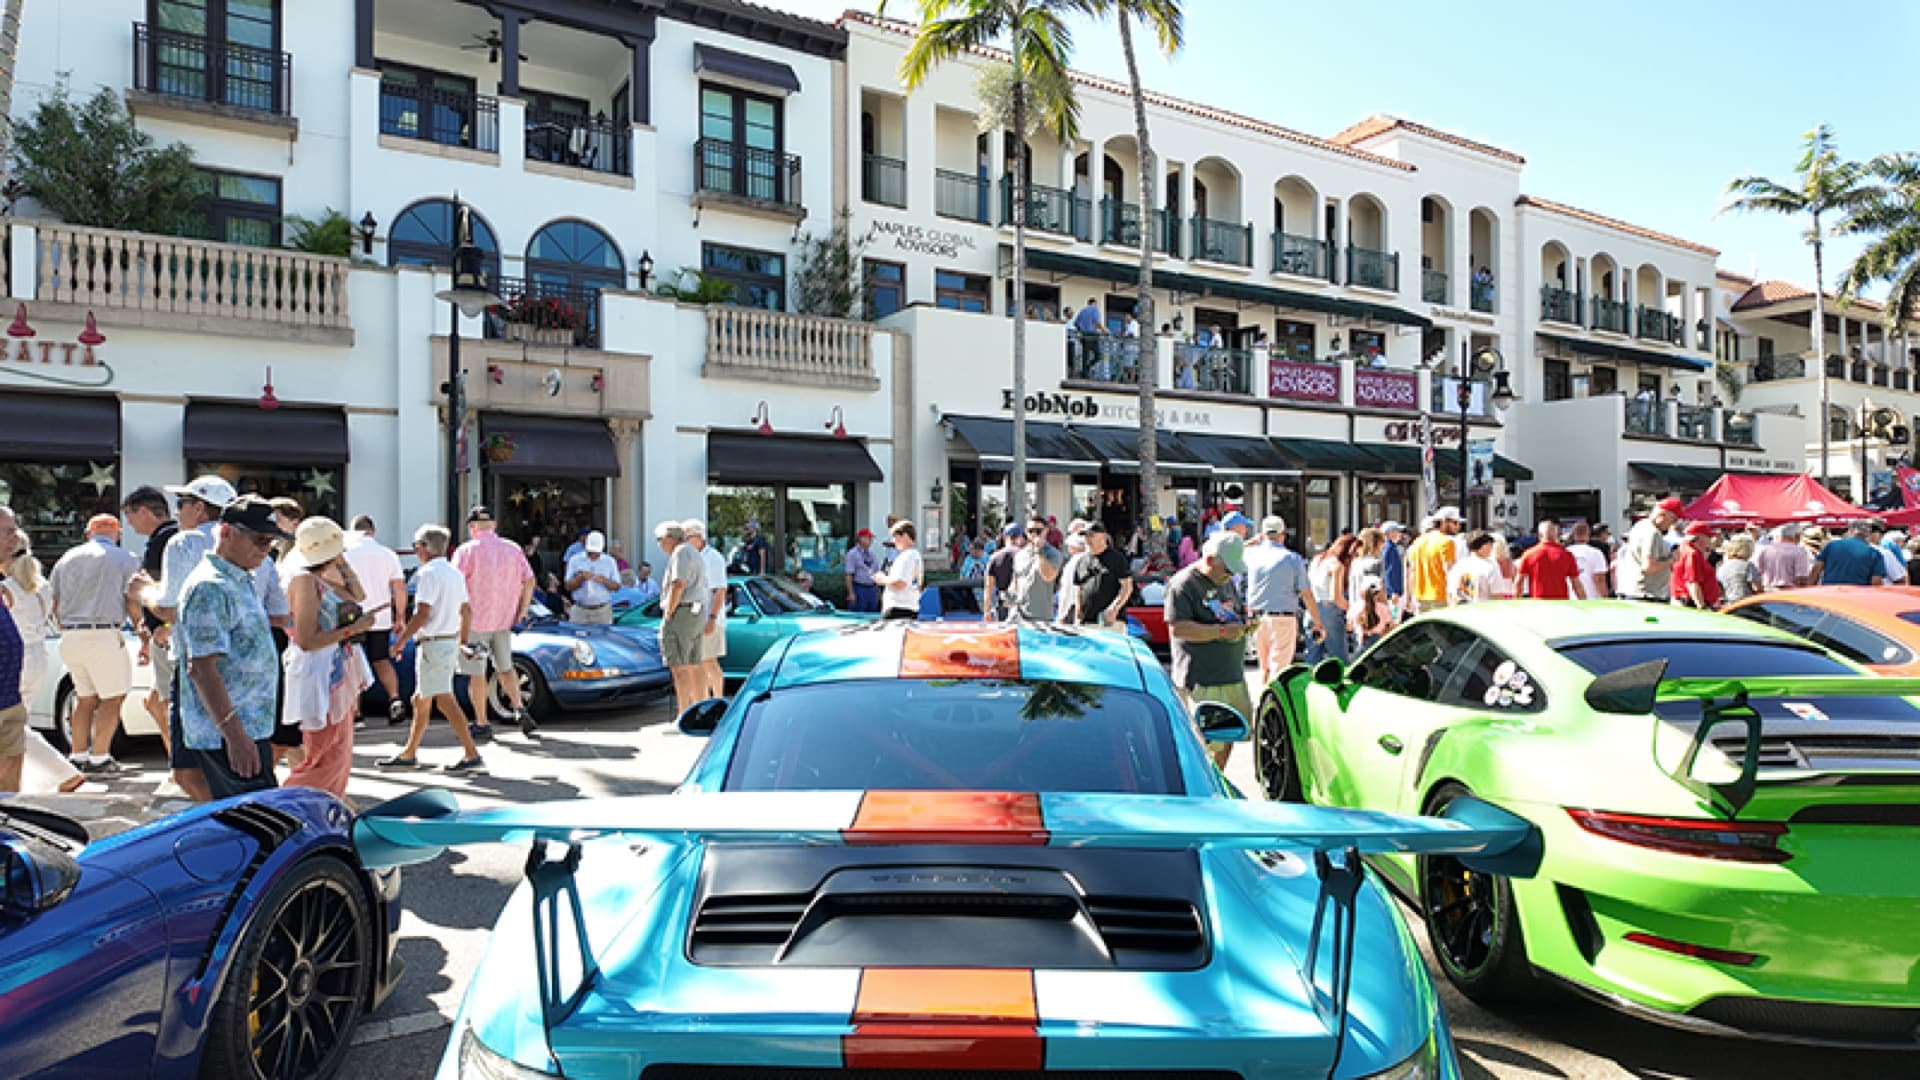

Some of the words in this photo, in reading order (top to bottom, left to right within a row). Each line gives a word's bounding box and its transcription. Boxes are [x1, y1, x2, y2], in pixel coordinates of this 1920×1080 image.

[873, 219, 923, 239] NAPLES
[926, 230, 976, 249] GLOBAL
[895, 237, 958, 258] ADVISORS
[1271, 376, 1336, 397] ADVISORS
[1358, 385, 1414, 404] ADVISORS
[1169, 409, 1179, 423] &
[1184, 411, 1210, 425] BAR
